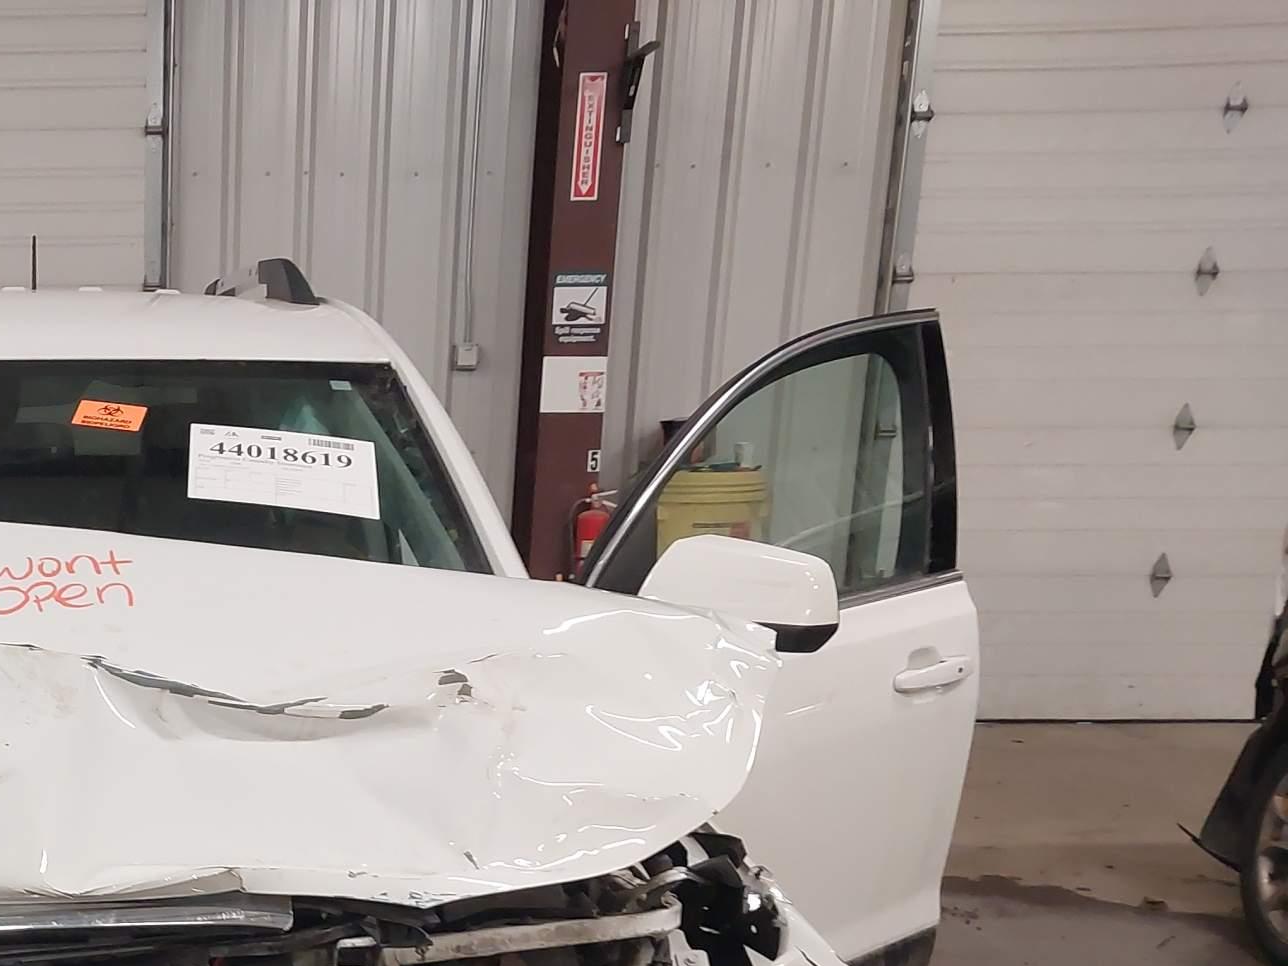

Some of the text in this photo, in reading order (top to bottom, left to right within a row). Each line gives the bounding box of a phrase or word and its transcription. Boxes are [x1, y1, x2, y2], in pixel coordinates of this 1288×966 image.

[580, 95, 595, 186] EXTINGUISHER
[556, 274, 606, 284] EMERGENCY
[83, 414, 132, 425] BIOHAZARD
[210, 441, 353, 469] 44018619
[590, 451, 599, 471] 5
